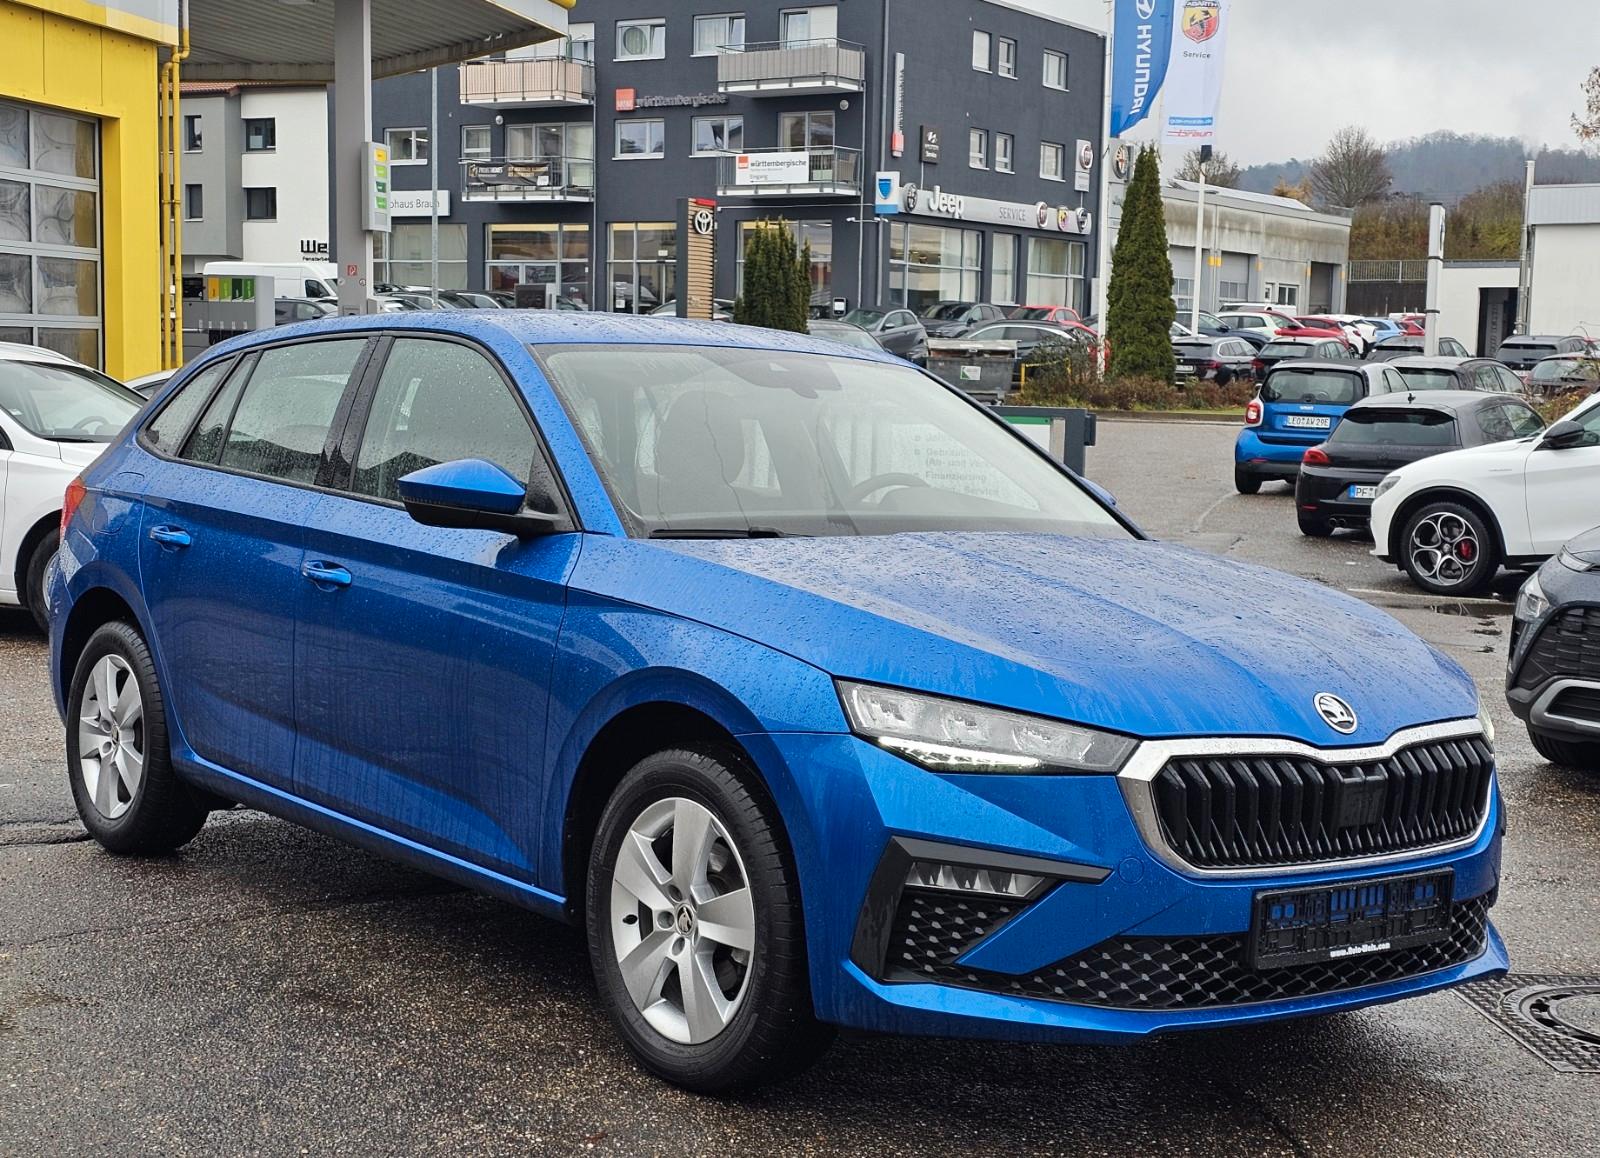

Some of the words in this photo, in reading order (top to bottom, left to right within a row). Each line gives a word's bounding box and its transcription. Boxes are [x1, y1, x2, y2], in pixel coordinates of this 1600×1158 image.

[1183, 51, 1211, 59] Service
[1129, 25, 1152, 114] HYUNDAI
[750, 160, 807, 168] württembergische
[928, 185, 964, 219] Jeep
[999, 206, 1026, 222] SERVICE
[1356, 487, 1369, 496] PF
